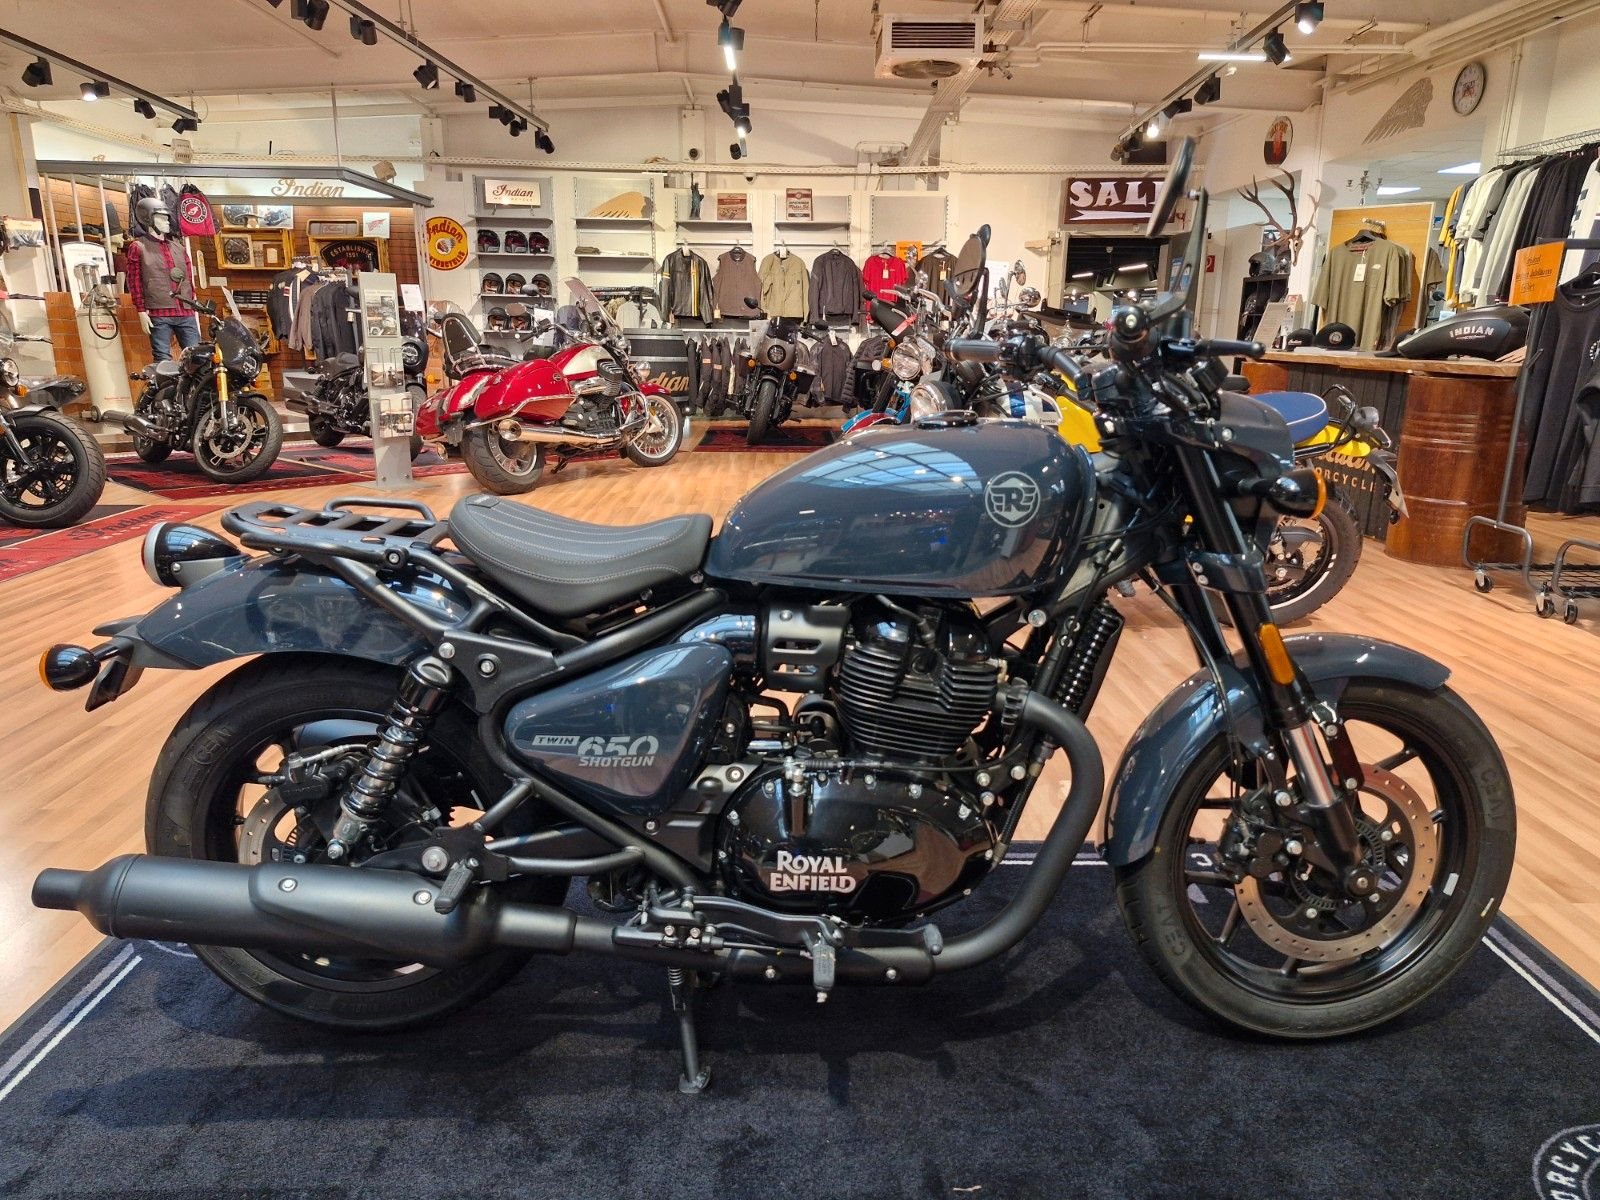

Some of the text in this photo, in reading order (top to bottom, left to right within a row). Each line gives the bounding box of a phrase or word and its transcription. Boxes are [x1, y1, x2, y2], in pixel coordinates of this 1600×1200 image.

[271, 178, 344, 198] Indian
[492, 184, 534, 197] Indian
[330, 244, 372, 258] ESTABLISHE
[1449, 325, 1495, 338] INDIAN
[646, 371, 690, 393] dian
[577, 735, 659, 757] 650
[578, 756, 656, 768] SHOTGUN
[776, 850, 848, 874] ROYAL
[769, 872, 857, 894] ENFIELD
